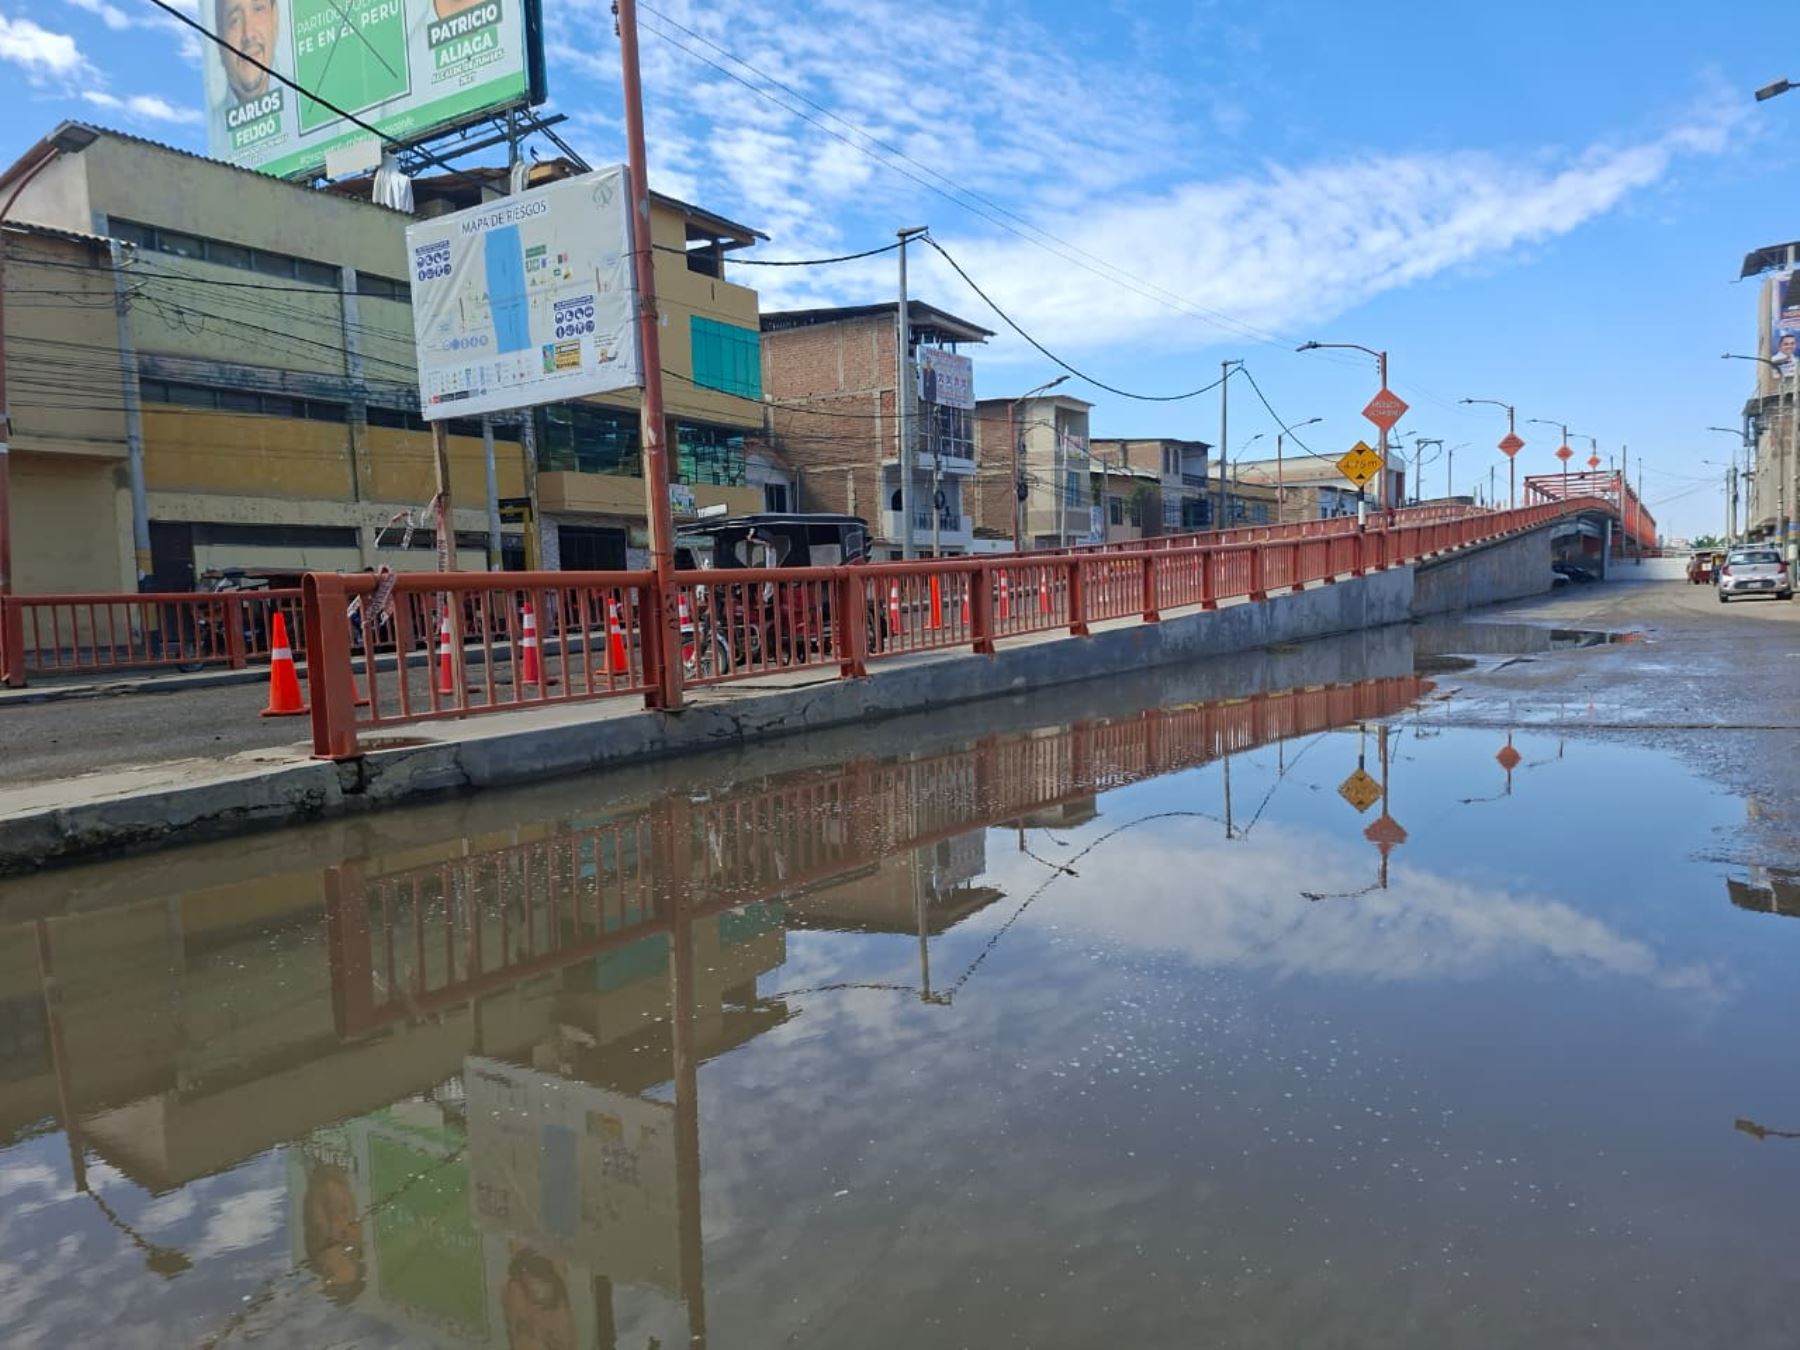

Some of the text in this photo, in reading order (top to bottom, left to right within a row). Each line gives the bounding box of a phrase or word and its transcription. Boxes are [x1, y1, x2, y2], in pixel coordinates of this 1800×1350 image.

[431, 4, 497, 44] PATRICIO
[298, 37, 314, 56] FE
[318, 27, 335, 47] EN
[440, 32, 493, 66] ALIAGA
[228, 92, 280, 127] CARLOS
[462, 200, 547, 234] MAPA DE RIESGOS
